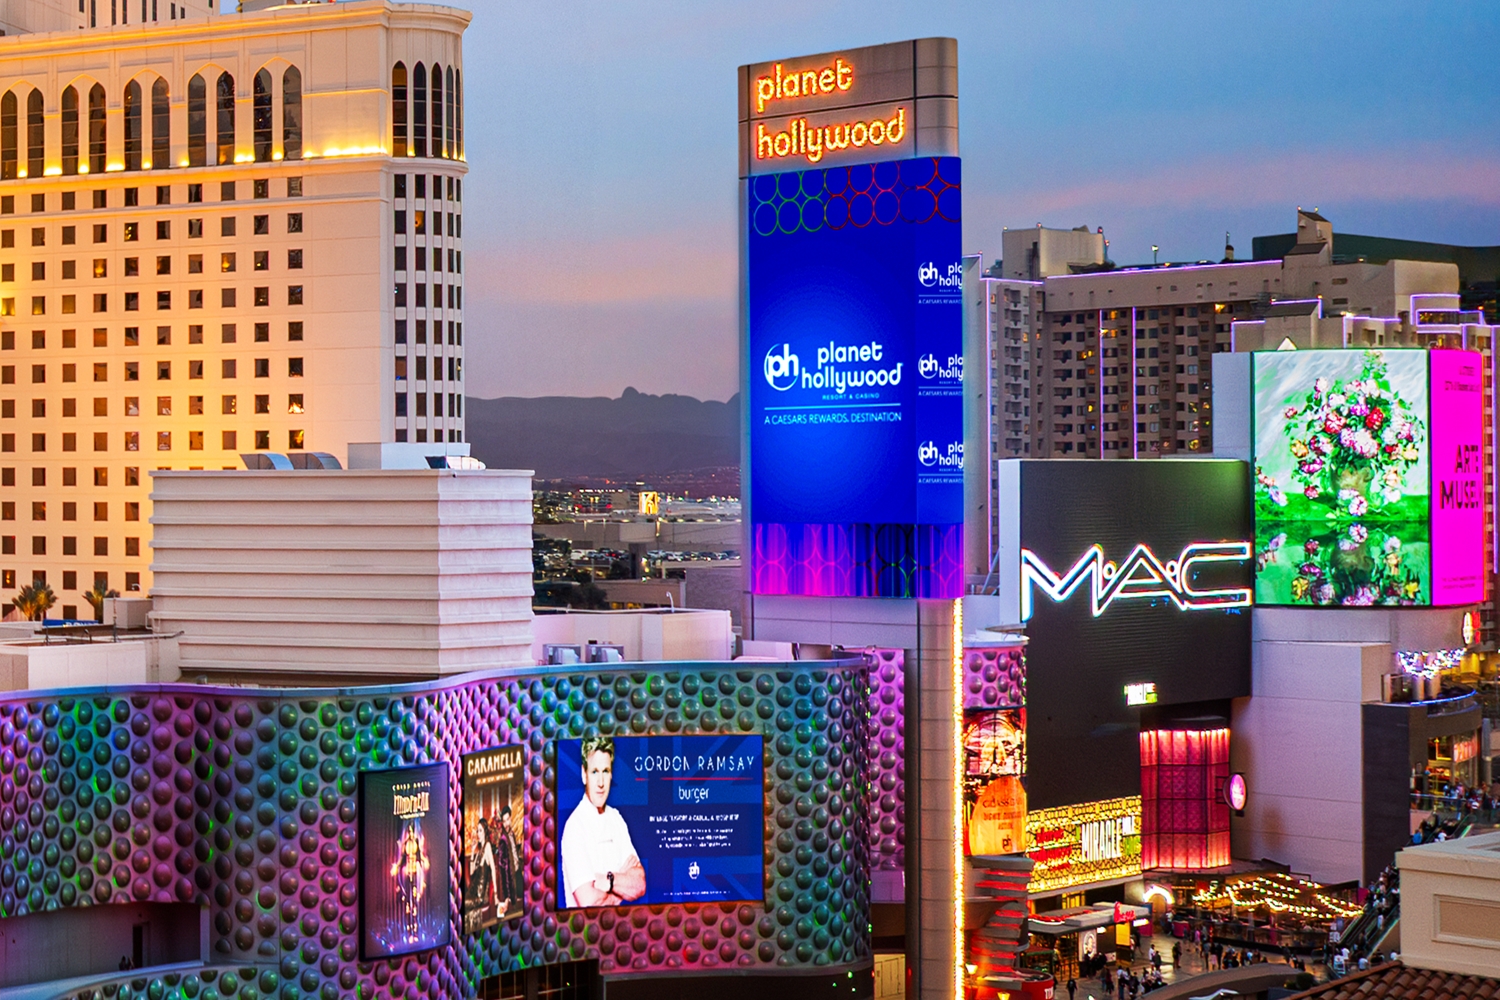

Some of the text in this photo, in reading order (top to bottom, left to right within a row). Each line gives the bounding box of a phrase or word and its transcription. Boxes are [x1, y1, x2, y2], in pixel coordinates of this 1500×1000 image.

[757, 58, 853, 114] planet
[756, 107, 905, 163] hollywood
[920, 262, 938, 284] ph
[766, 343, 799, 386] ph
[817, 341, 883, 370] planet
[920, 354, 938, 376] ph
[801, 362, 903, 394] hollywood
[764, 415, 771, 425] A
[771, 414, 807, 425] CAESARS
[851, 412, 902, 423] DESTINATION
[920, 441, 938, 463] ph
[467, 751, 522, 776] CARAMELLA
[634, 755, 754, 771] GORDON RAMSAY
[678, 785, 710, 804] burger
[1081, 818, 1122, 863] MIRACLE
